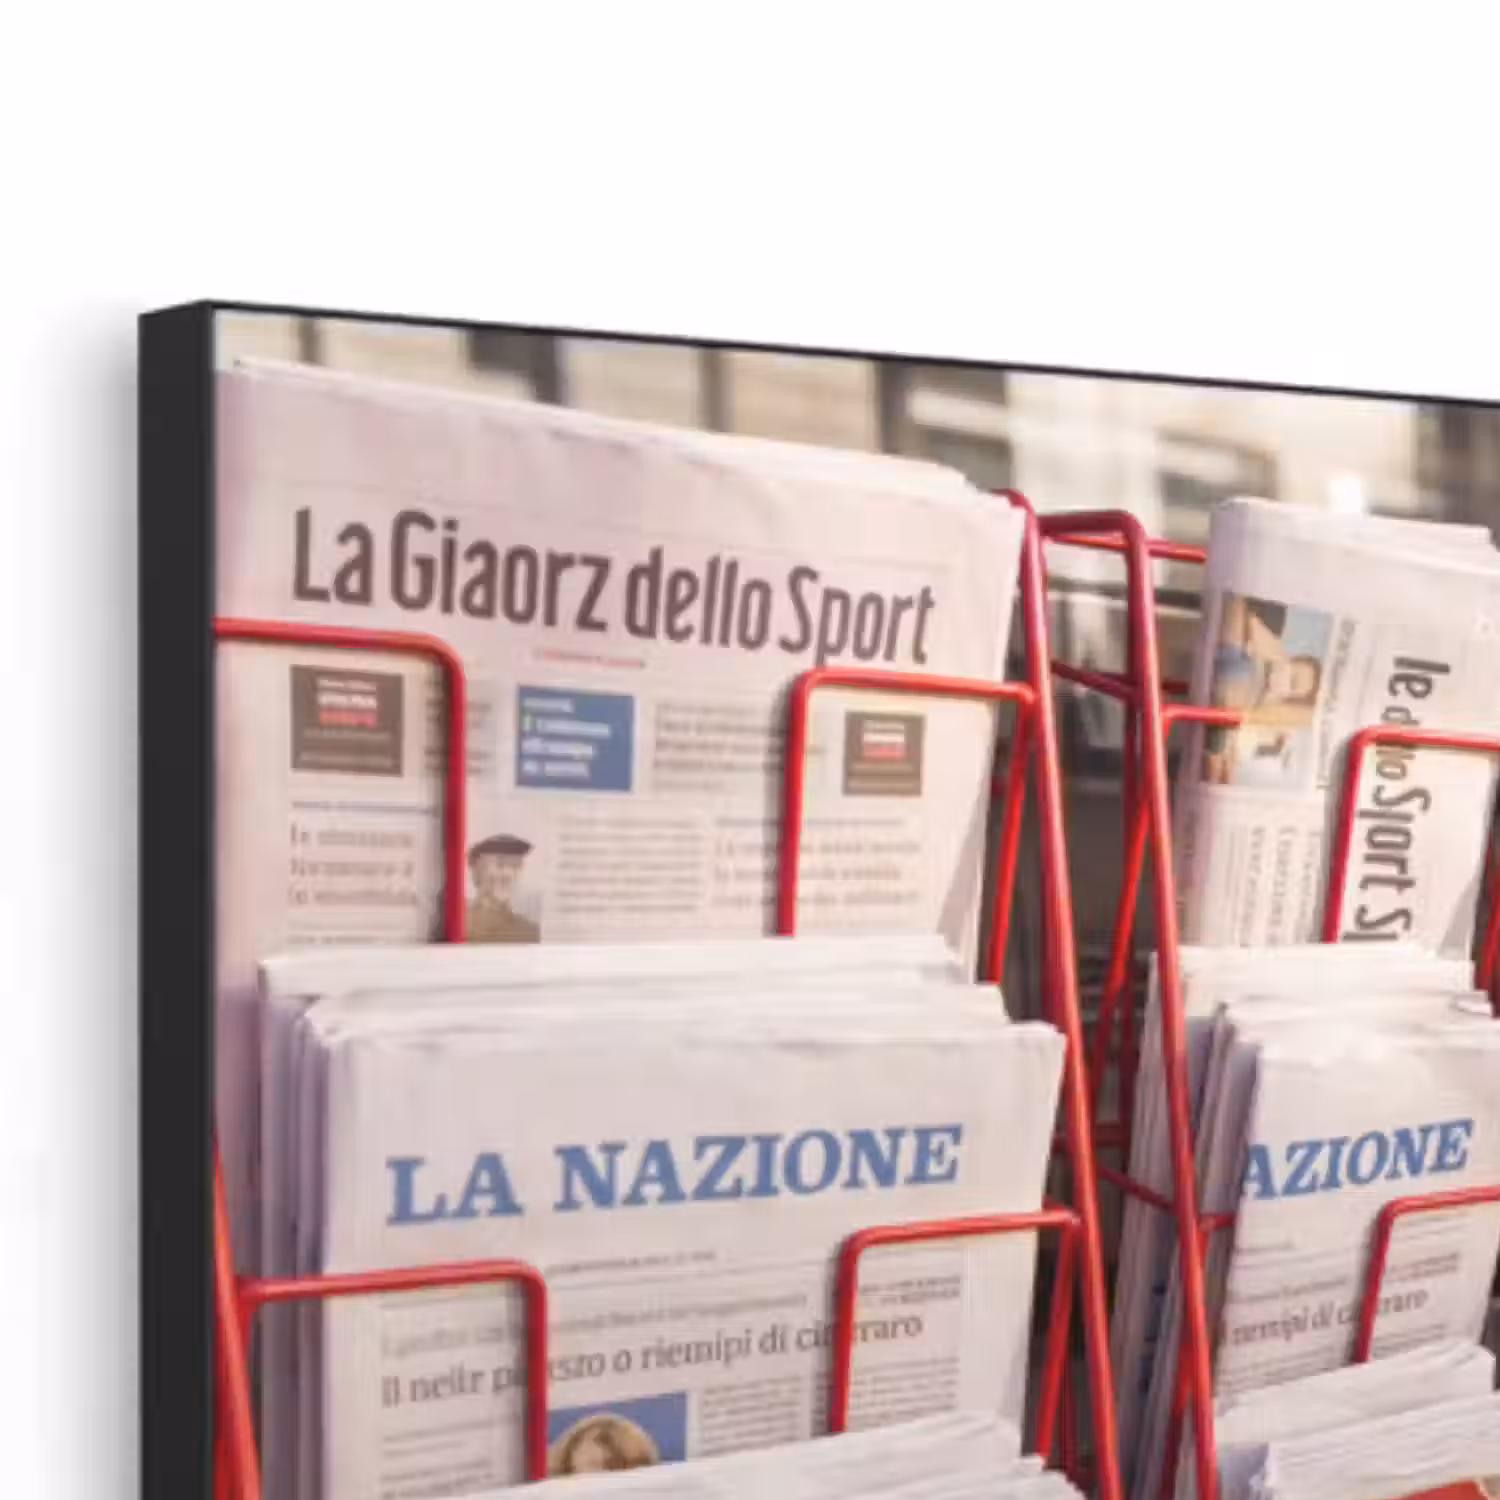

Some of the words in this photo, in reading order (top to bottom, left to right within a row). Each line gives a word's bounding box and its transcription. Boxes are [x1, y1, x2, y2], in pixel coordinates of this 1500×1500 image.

[293, 505, 374, 606] La
[389, 508, 612, 632] Giaorz
[624, 545, 772, 651] dello
[779, 564, 936, 668] Sport
[384, 1151, 526, 1226] LA
[553, 1122, 964, 1212] NAZIONE
